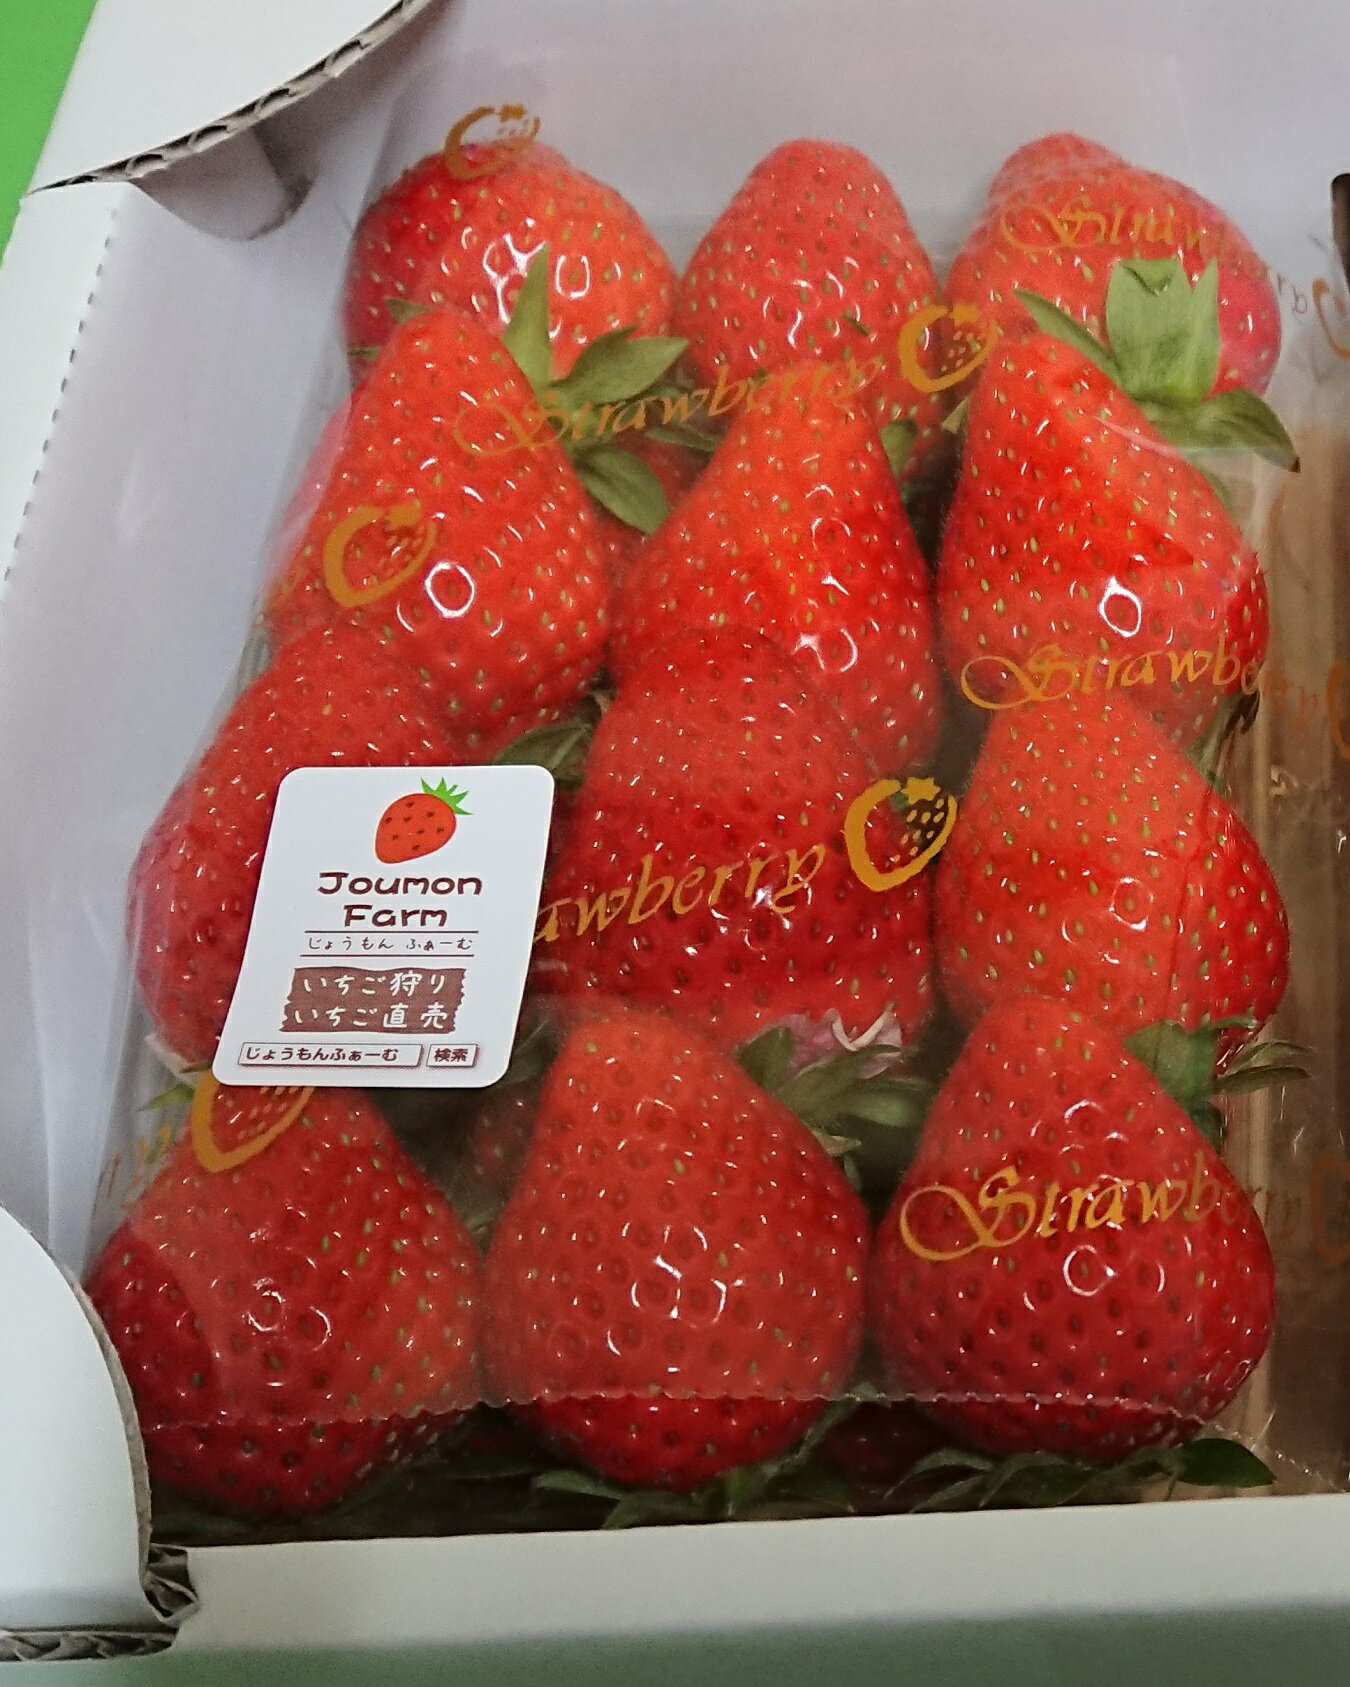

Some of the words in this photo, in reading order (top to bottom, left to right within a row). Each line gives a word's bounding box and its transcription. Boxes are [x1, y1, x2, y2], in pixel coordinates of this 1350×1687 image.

[316, 871, 483, 896] Joumon
[342, 903, 449, 928] Farm
[303, 970, 448, 998] いちご狩り
[294, 1002, 449, 1031] いちご直売
[245, 1046, 399, 1063] じょうもんふぁーむ
[433, 1047, 470, 1065] 検索
